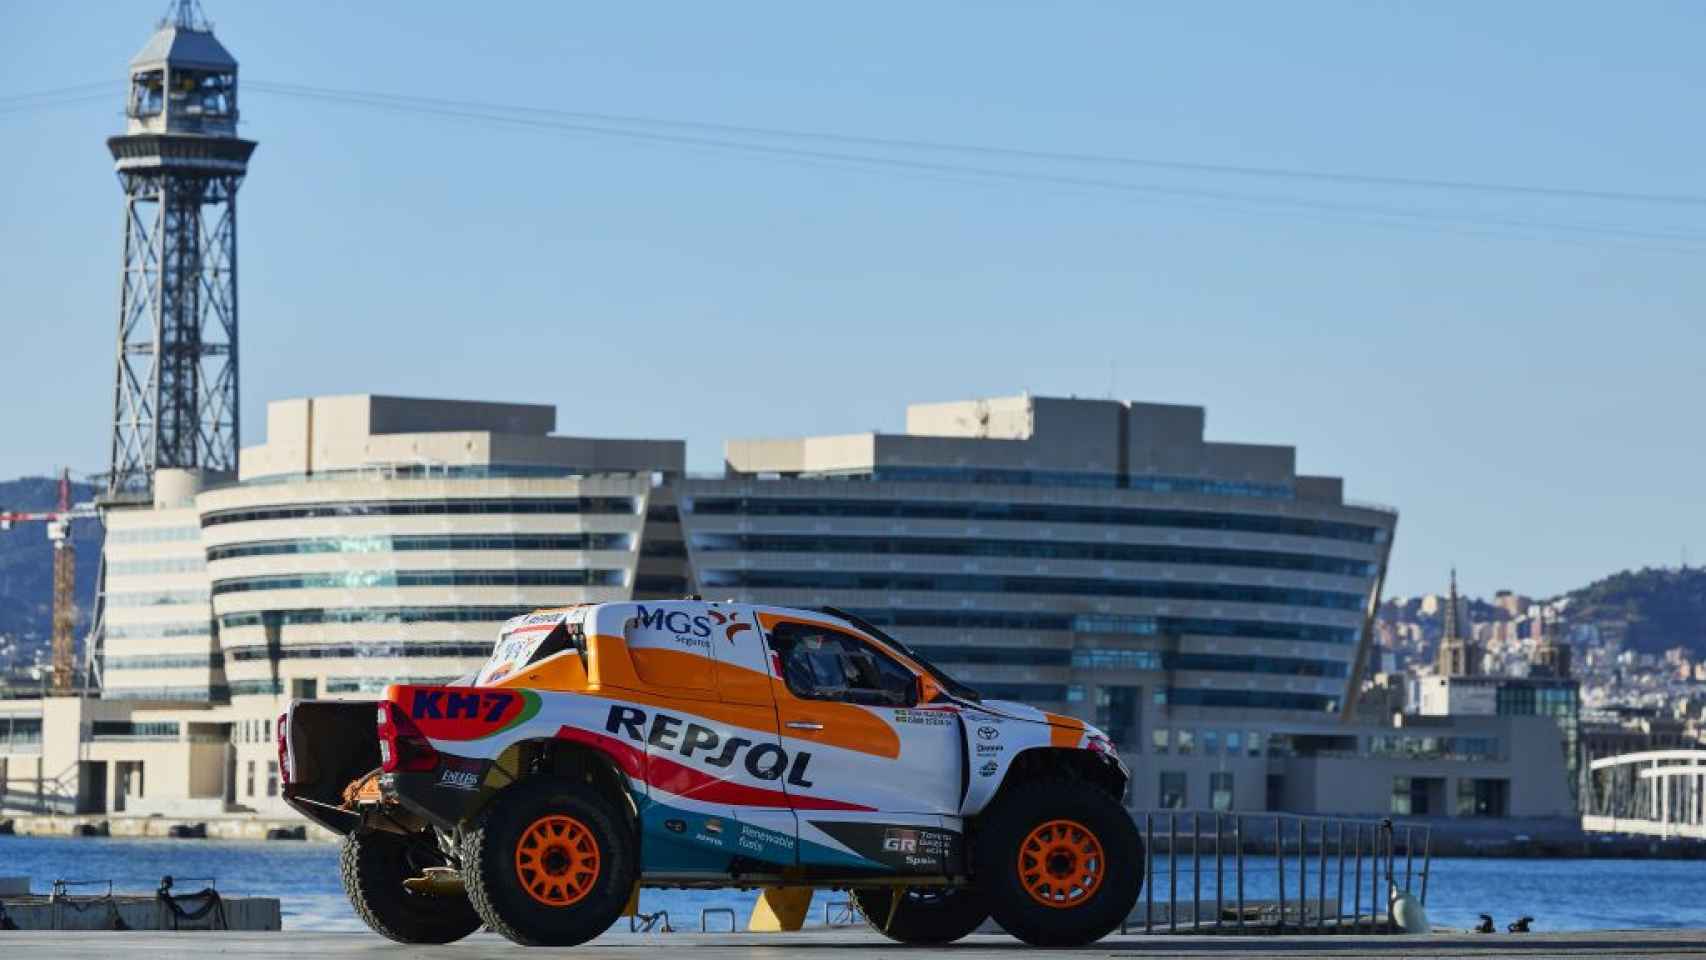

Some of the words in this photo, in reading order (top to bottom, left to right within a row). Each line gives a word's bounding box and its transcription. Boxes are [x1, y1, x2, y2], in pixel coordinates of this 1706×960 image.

[637, 604, 711, 637] MGS
[606, 704, 814, 788] REPSOL
[742, 825, 794, 849] Renewable
[883, 837, 917, 853] GR
[905, 855, 937, 866] Spain
